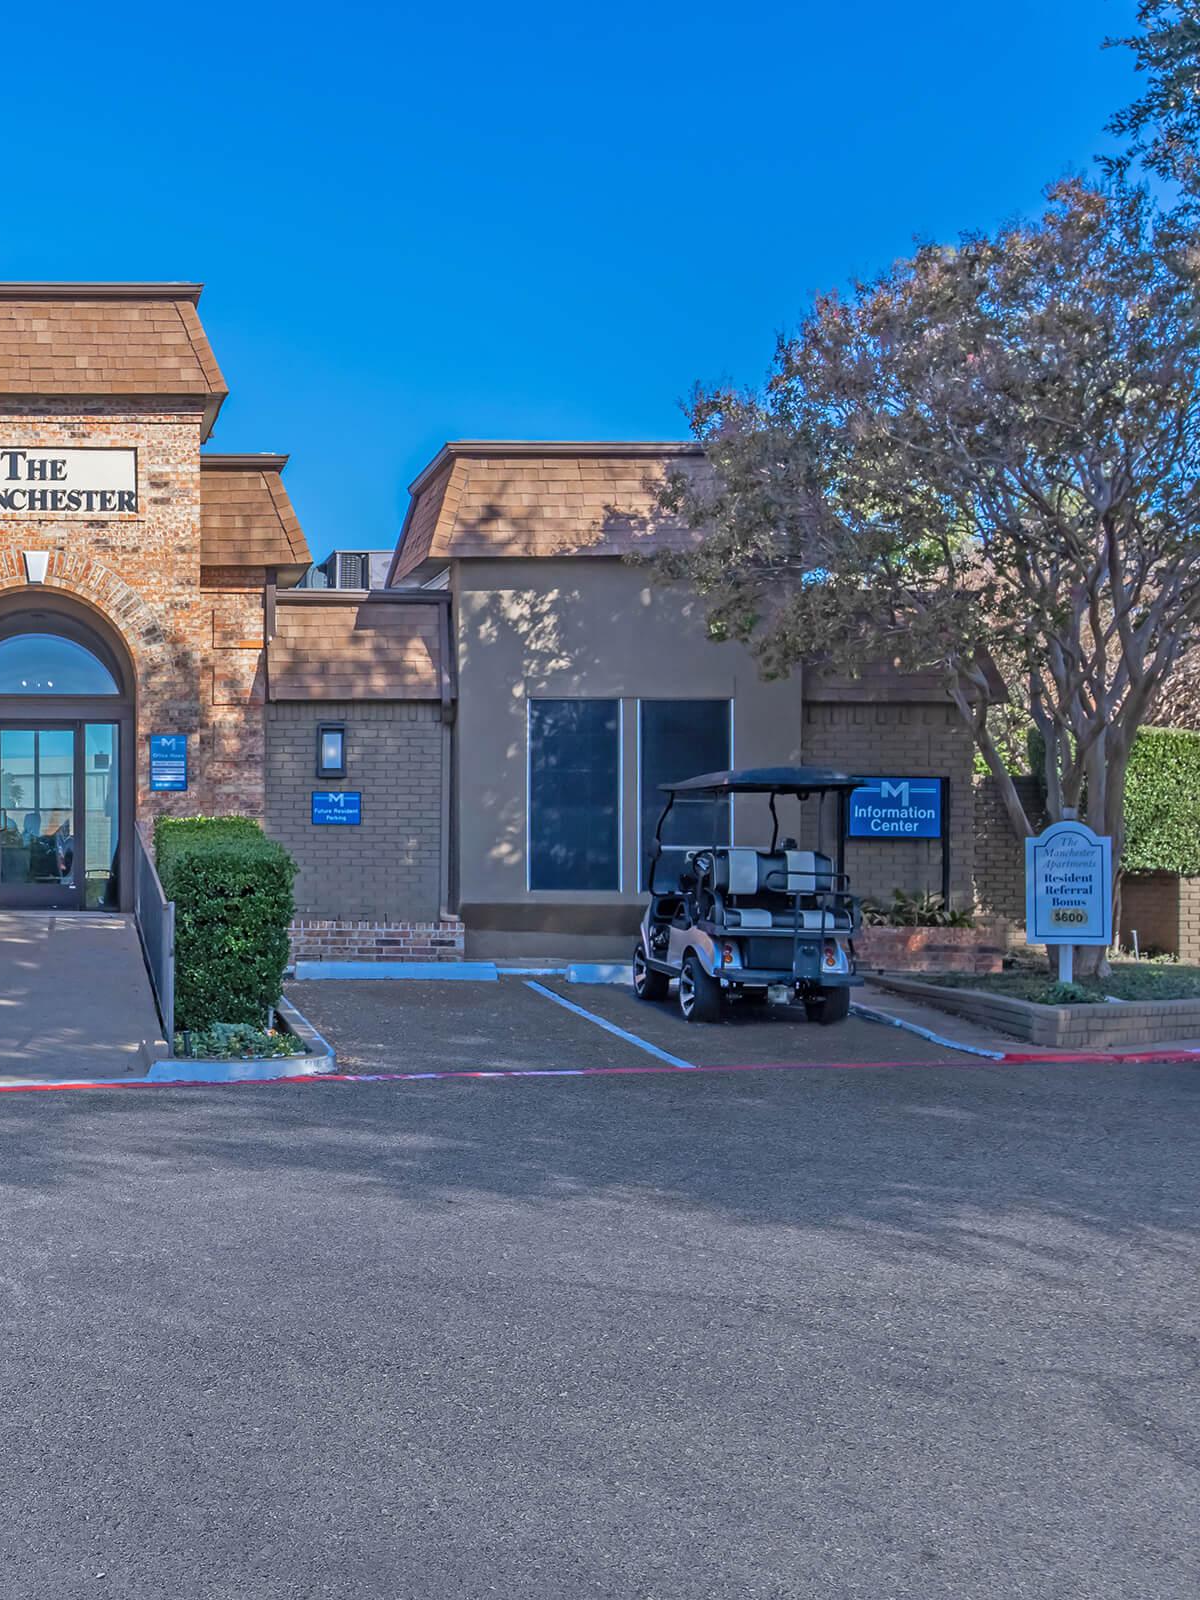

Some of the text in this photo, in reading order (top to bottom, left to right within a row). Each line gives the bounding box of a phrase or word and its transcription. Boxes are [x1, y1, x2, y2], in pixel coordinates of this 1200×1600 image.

[0, 450, 68, 481] THE
[881, 781, 909, 807] M
[854, 805, 936, 819] Information
[870, 818, 919, 832] Center
[1060, 836, 1079, 847] The
[1043, 848, 1097, 858] Manchester
[1044, 872, 1093, 883] Resident
[1045, 884, 1093, 895] Referral
[1051, 897, 1087, 907] Bonus
